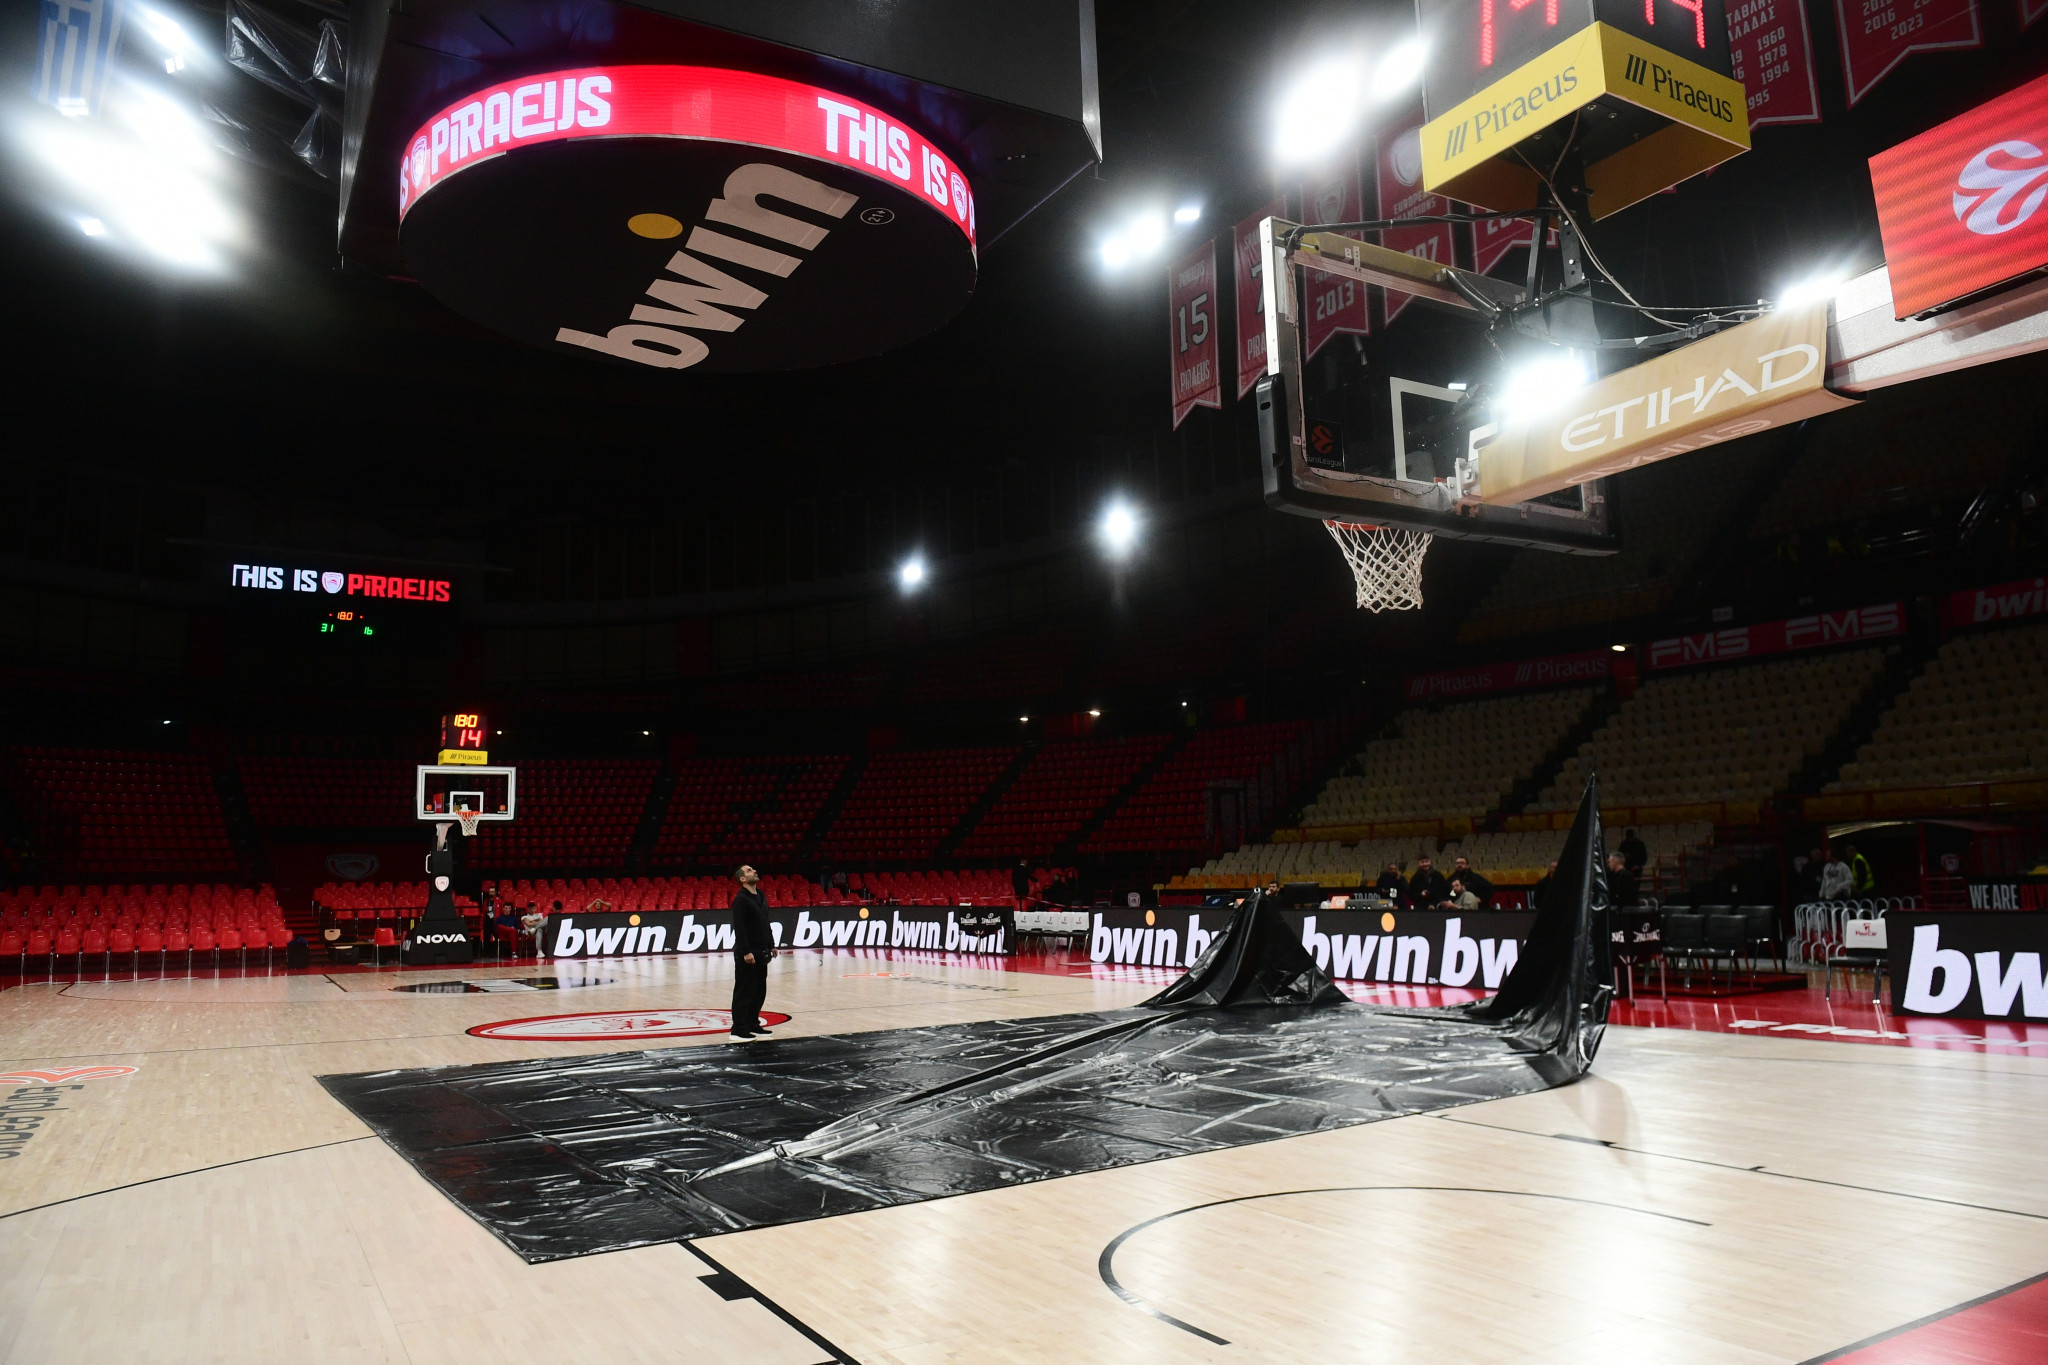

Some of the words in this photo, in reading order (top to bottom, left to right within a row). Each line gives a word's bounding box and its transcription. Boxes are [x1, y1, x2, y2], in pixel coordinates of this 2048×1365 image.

[1757, 26, 1785, 51] 1960
[1864, 8, 1896, 34] 2016
[1890, 13, 1923, 40] 2023
[1760, 43, 1788, 68] 1978
[1761, 60, 1790, 86] 1994
[1474, 65, 1578, 144] Piraeus
[1652, 63, 1734, 124] Piraeus
[1746, 89, 1770, 111] 995
[818, 97, 912, 181] THIS
[922, 145, 949, 206] IS
[555, 163, 860, 370] bwin
[1316, 280, 1354, 321] 2013
[1178, 292, 1209, 353] 15
[1180, 359, 1210, 393] PIRAEUS
[1561, 344, 1820, 453] ETIHAD
[232, 564, 284, 590] THIS
[293, 569, 317, 592] IS
[1973, 577, 2048, 622] bwi
[1650, 626, 1750, 666] FMS
[1785, 603, 1900, 646] FMS
[1430, 671, 1493, 694] Piraeus
[1537, 657, 1608, 681] Piraeus
[457, 753, 483, 761] Piraeus
[460, 729, 482, 748] 14
[1969, 884, 1991, 910] WE
[1992, 884, 2020, 911] ARE
[416, 933, 467, 944] NOVA
[553, 914, 667, 957] bwin
[676, 914, 784, 952] bwn
[793, 908, 888, 947] bwin
[891, 910, 941, 949] bwin
[1090, 910, 1178, 967] bwin
[1301, 912, 1430, 985] bwin
